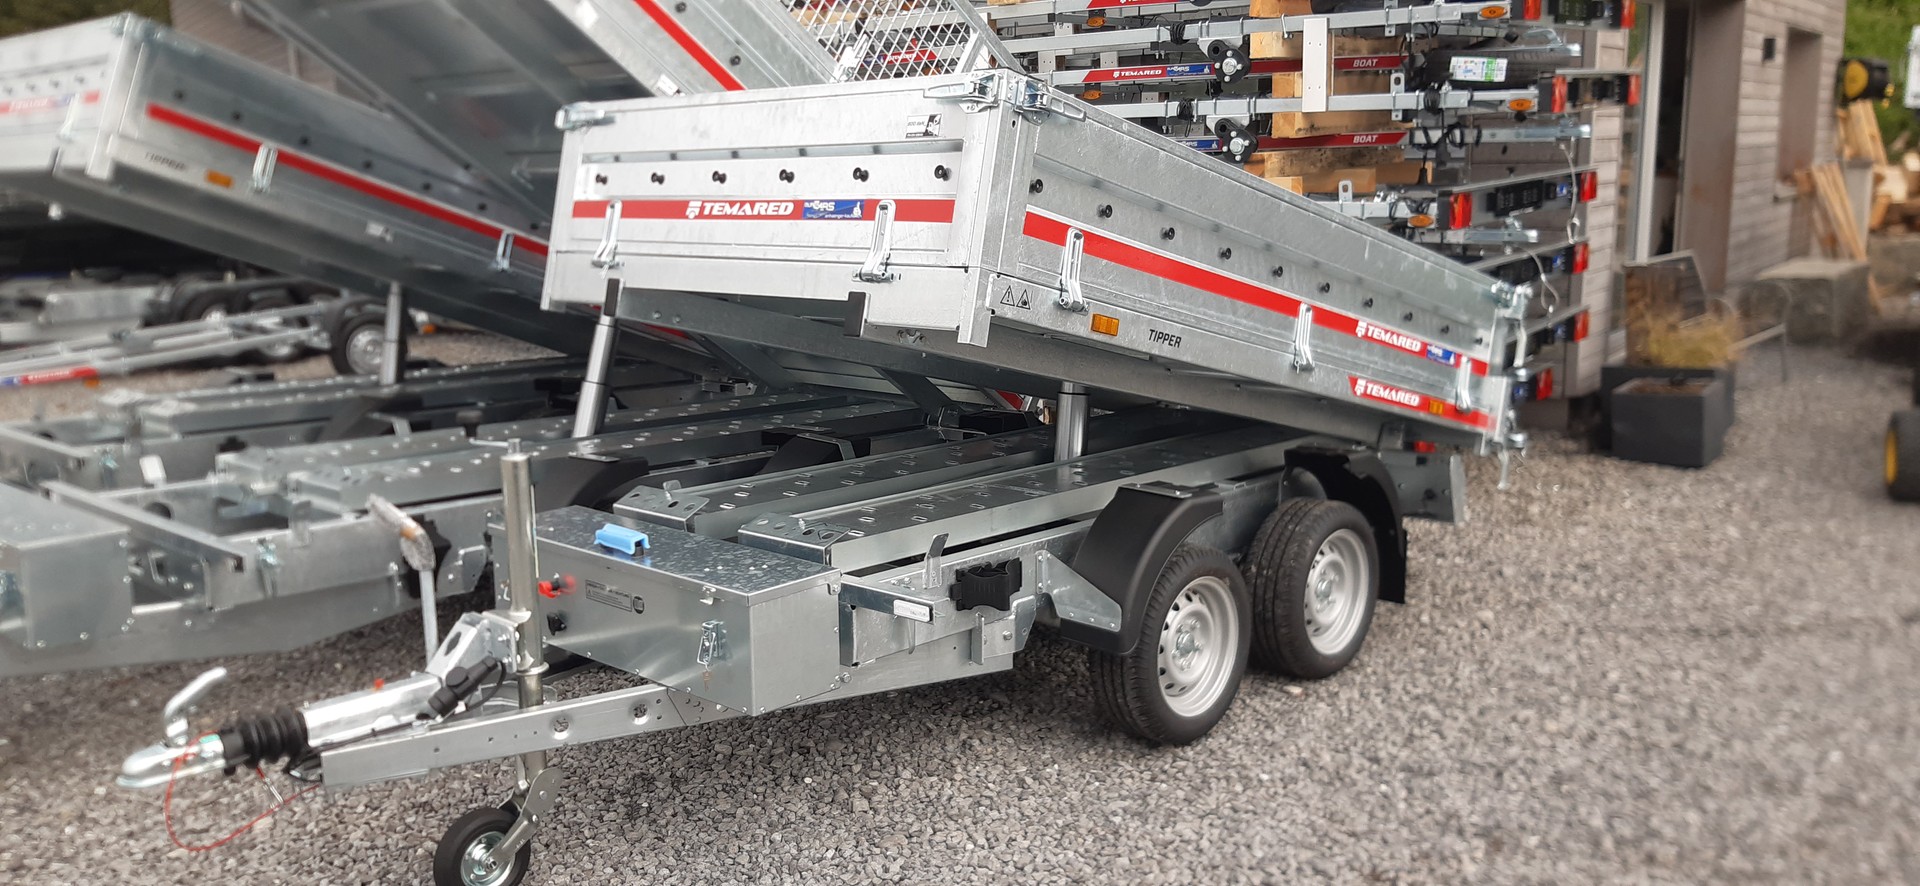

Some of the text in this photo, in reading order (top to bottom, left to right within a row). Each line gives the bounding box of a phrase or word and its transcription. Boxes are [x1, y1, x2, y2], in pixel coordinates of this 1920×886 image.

[1353, 59, 1378, 68] BOAT
[1120, 69, 1162, 77] TEMARED
[1353, 135, 1378, 144] BOAT
[703, 202, 795, 216] TEMARED
[1149, 328, 1182, 349] TIPPER
[1366, 324, 1422, 353] TEMARED
[1366, 382, 1420, 408] TEMARED
